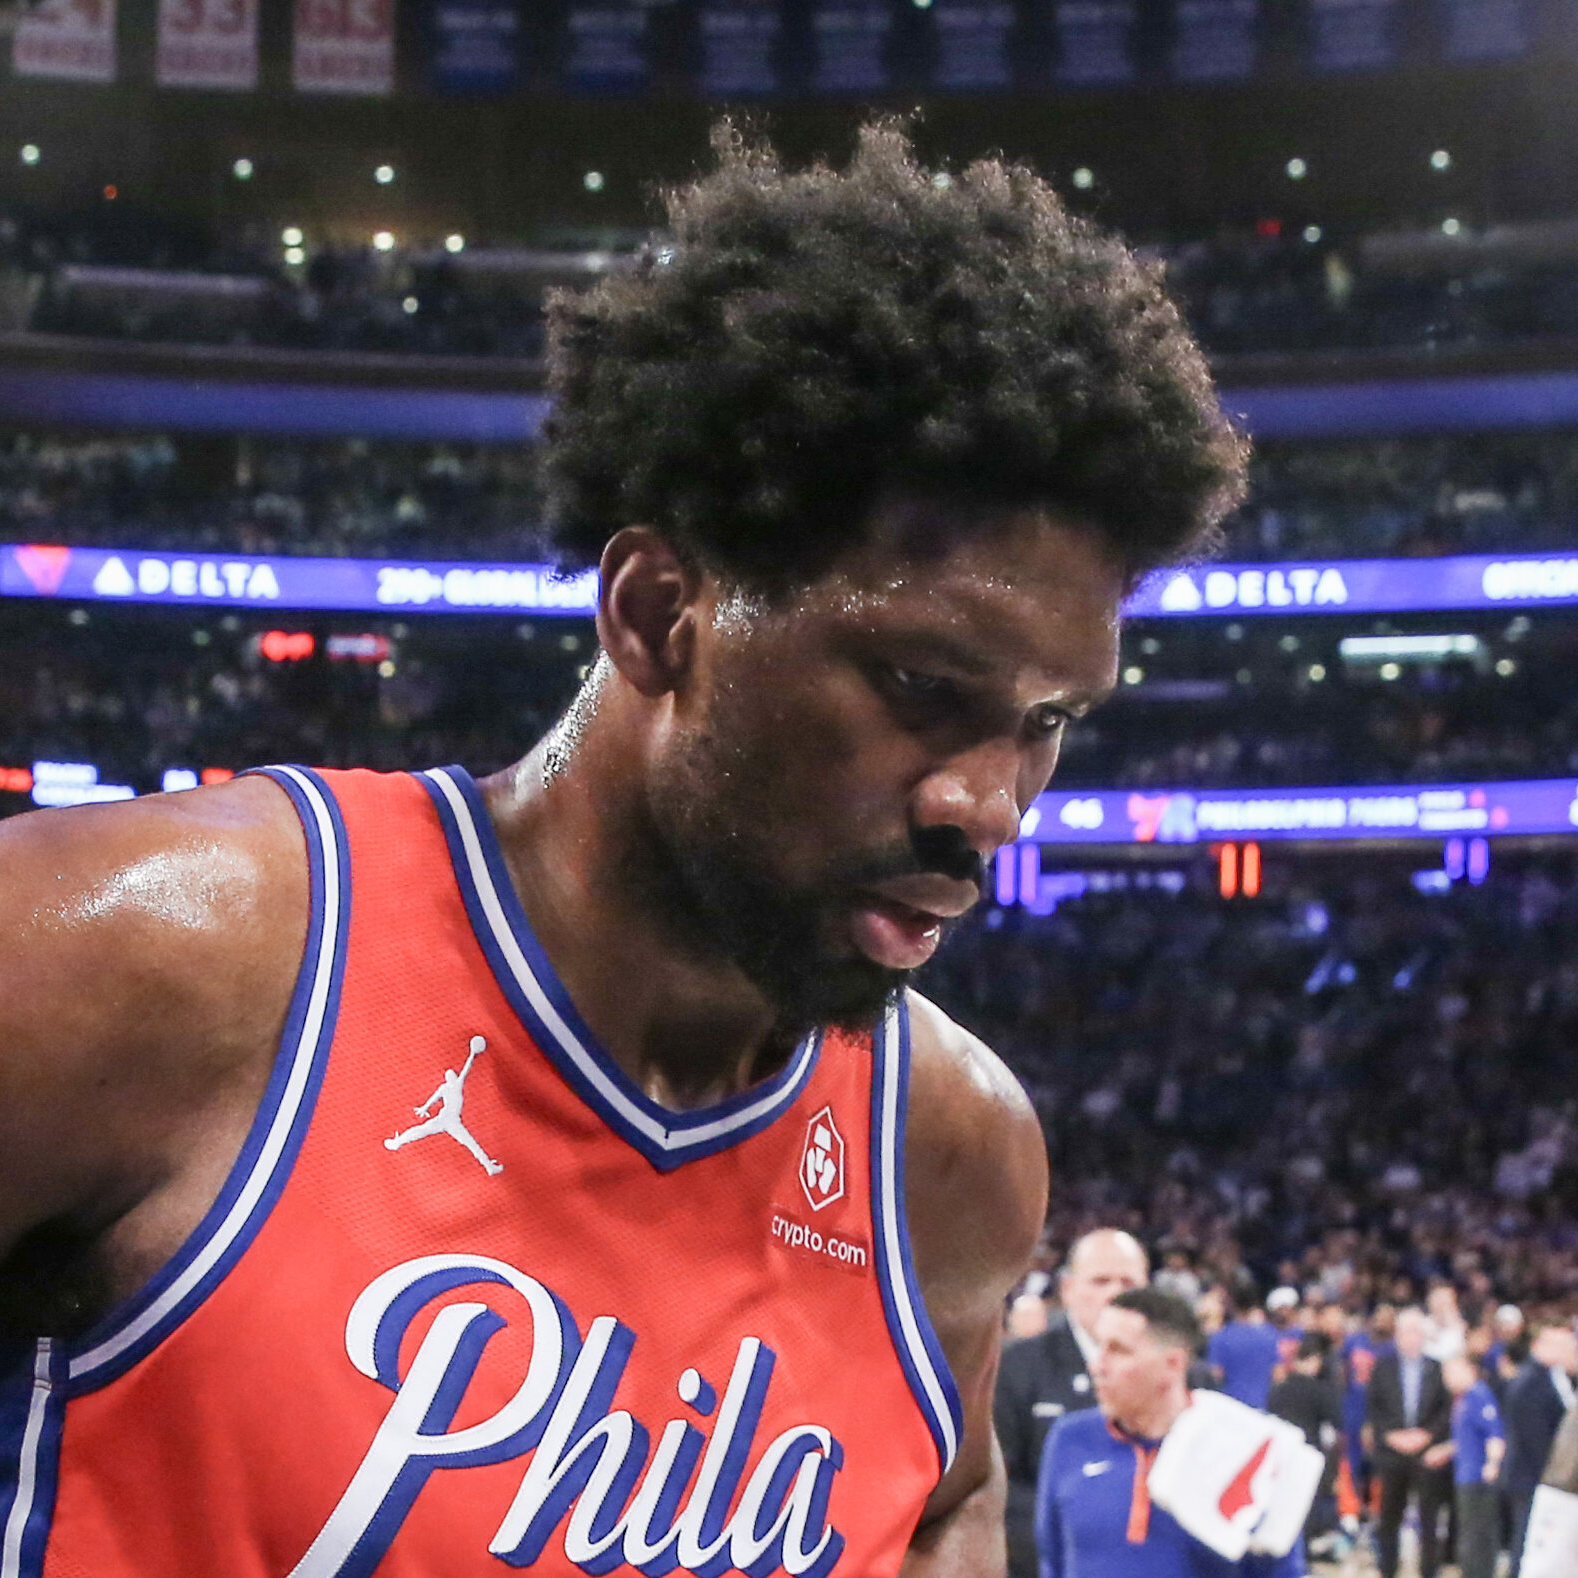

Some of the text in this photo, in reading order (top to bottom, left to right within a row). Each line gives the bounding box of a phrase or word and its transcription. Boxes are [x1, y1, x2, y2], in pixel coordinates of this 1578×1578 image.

[138, 558, 280, 600] DELTA
[1204, 567, 1348, 608] DELTA
[771, 1215, 867, 1267] crypto.com
